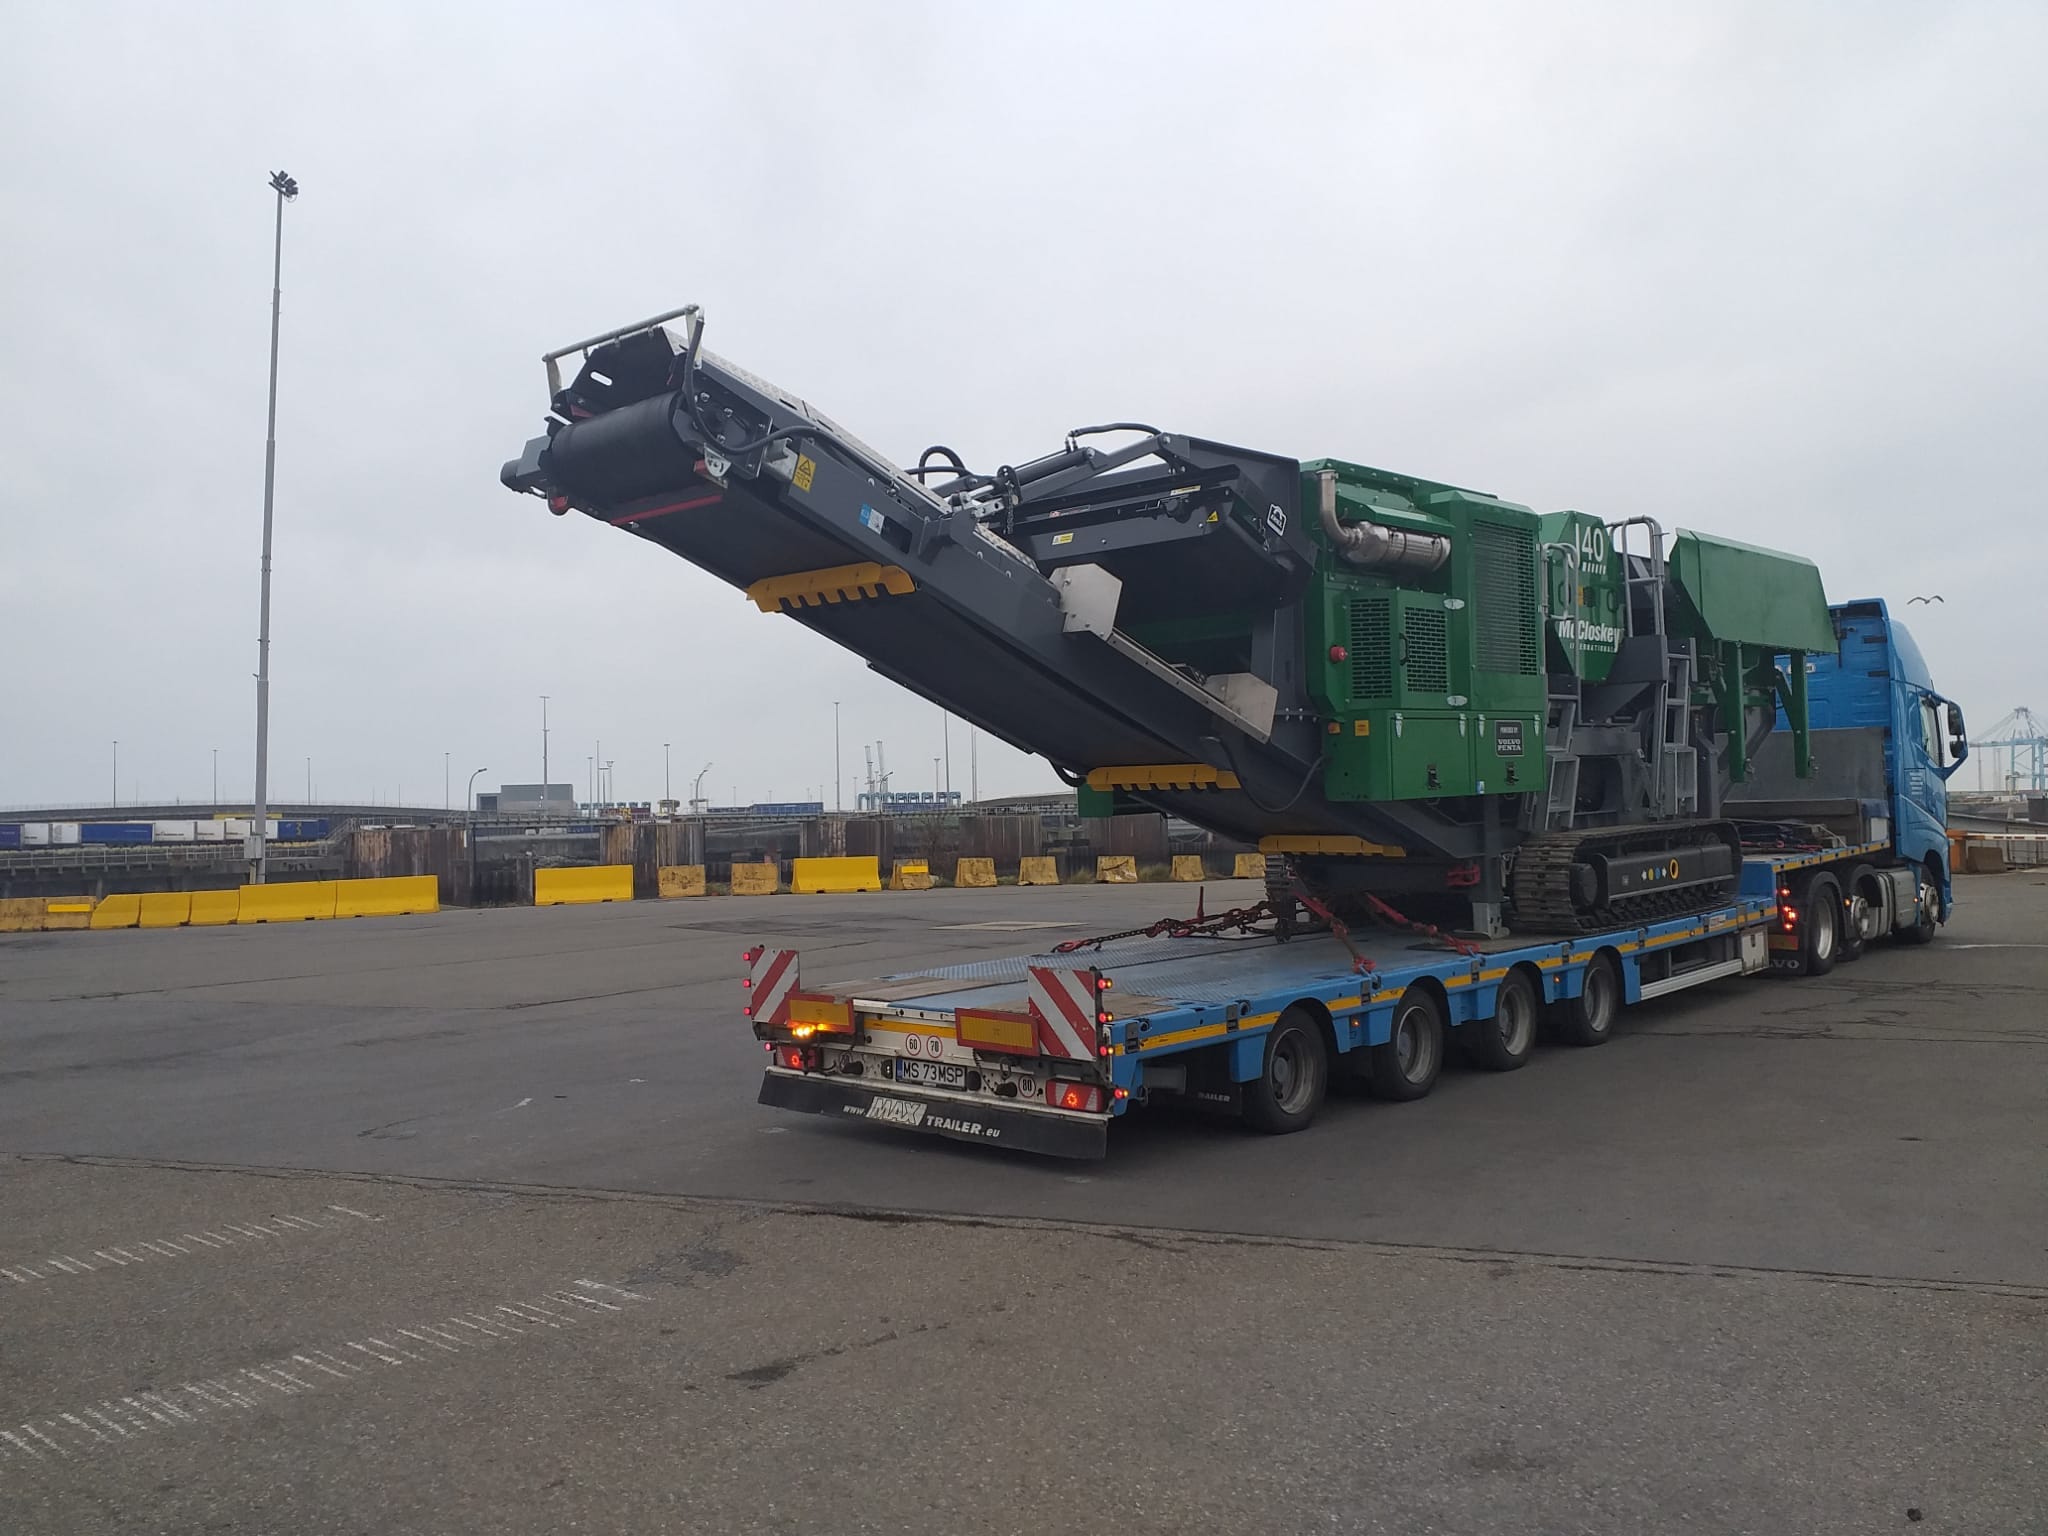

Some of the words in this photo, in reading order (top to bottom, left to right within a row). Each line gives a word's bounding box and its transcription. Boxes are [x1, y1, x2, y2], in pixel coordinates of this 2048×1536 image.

[909, 1039, 918, 1050] 60
[903, 1061, 920, 1079] MS
[1022, 1078, 1032, 1092] 80
